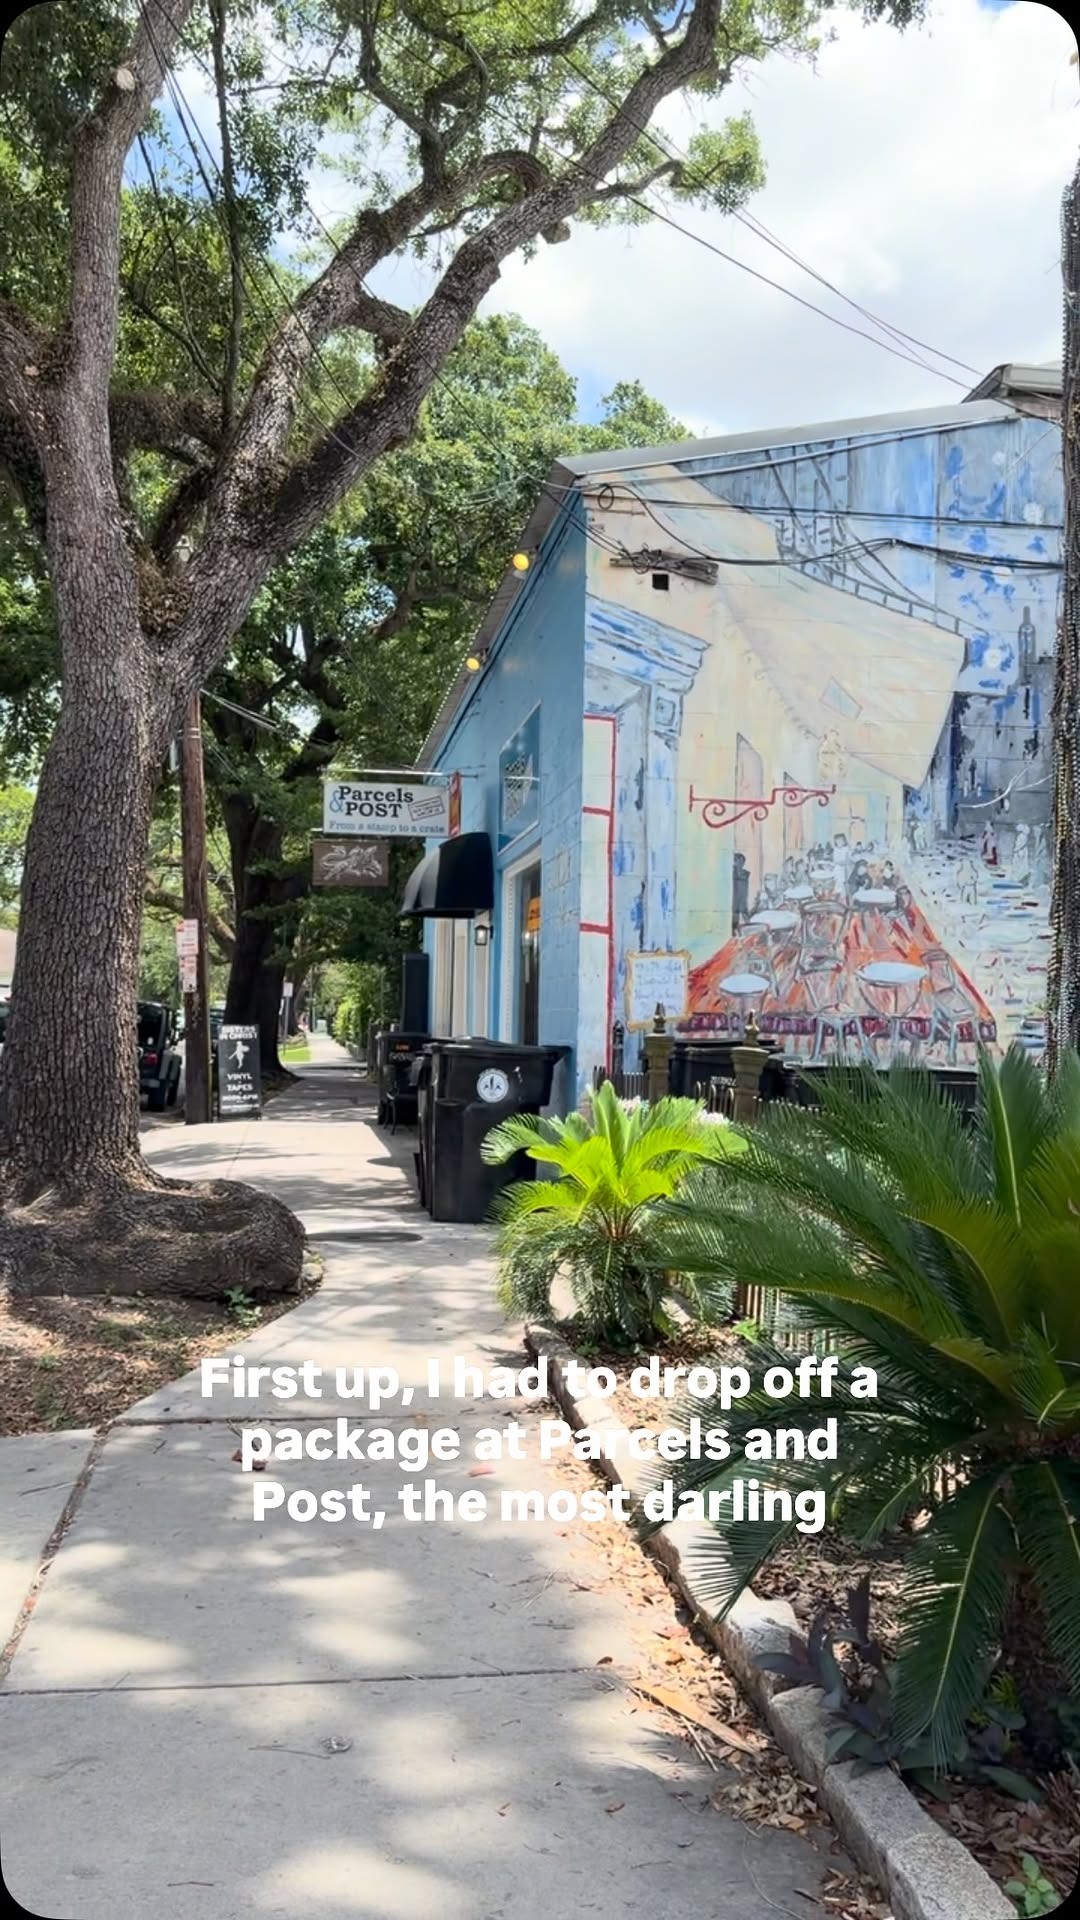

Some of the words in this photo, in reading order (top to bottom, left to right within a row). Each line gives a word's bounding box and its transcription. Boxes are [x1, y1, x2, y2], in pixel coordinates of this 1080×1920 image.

[338, 786, 414, 803] Parcels
[329, 789, 343, 813] &
[345, 802, 402, 818] POST
[329, 821, 356, 831] From
[367, 823, 397, 833] stamp
[399, 823, 409, 832] to
[419, 825, 445, 833] crate
